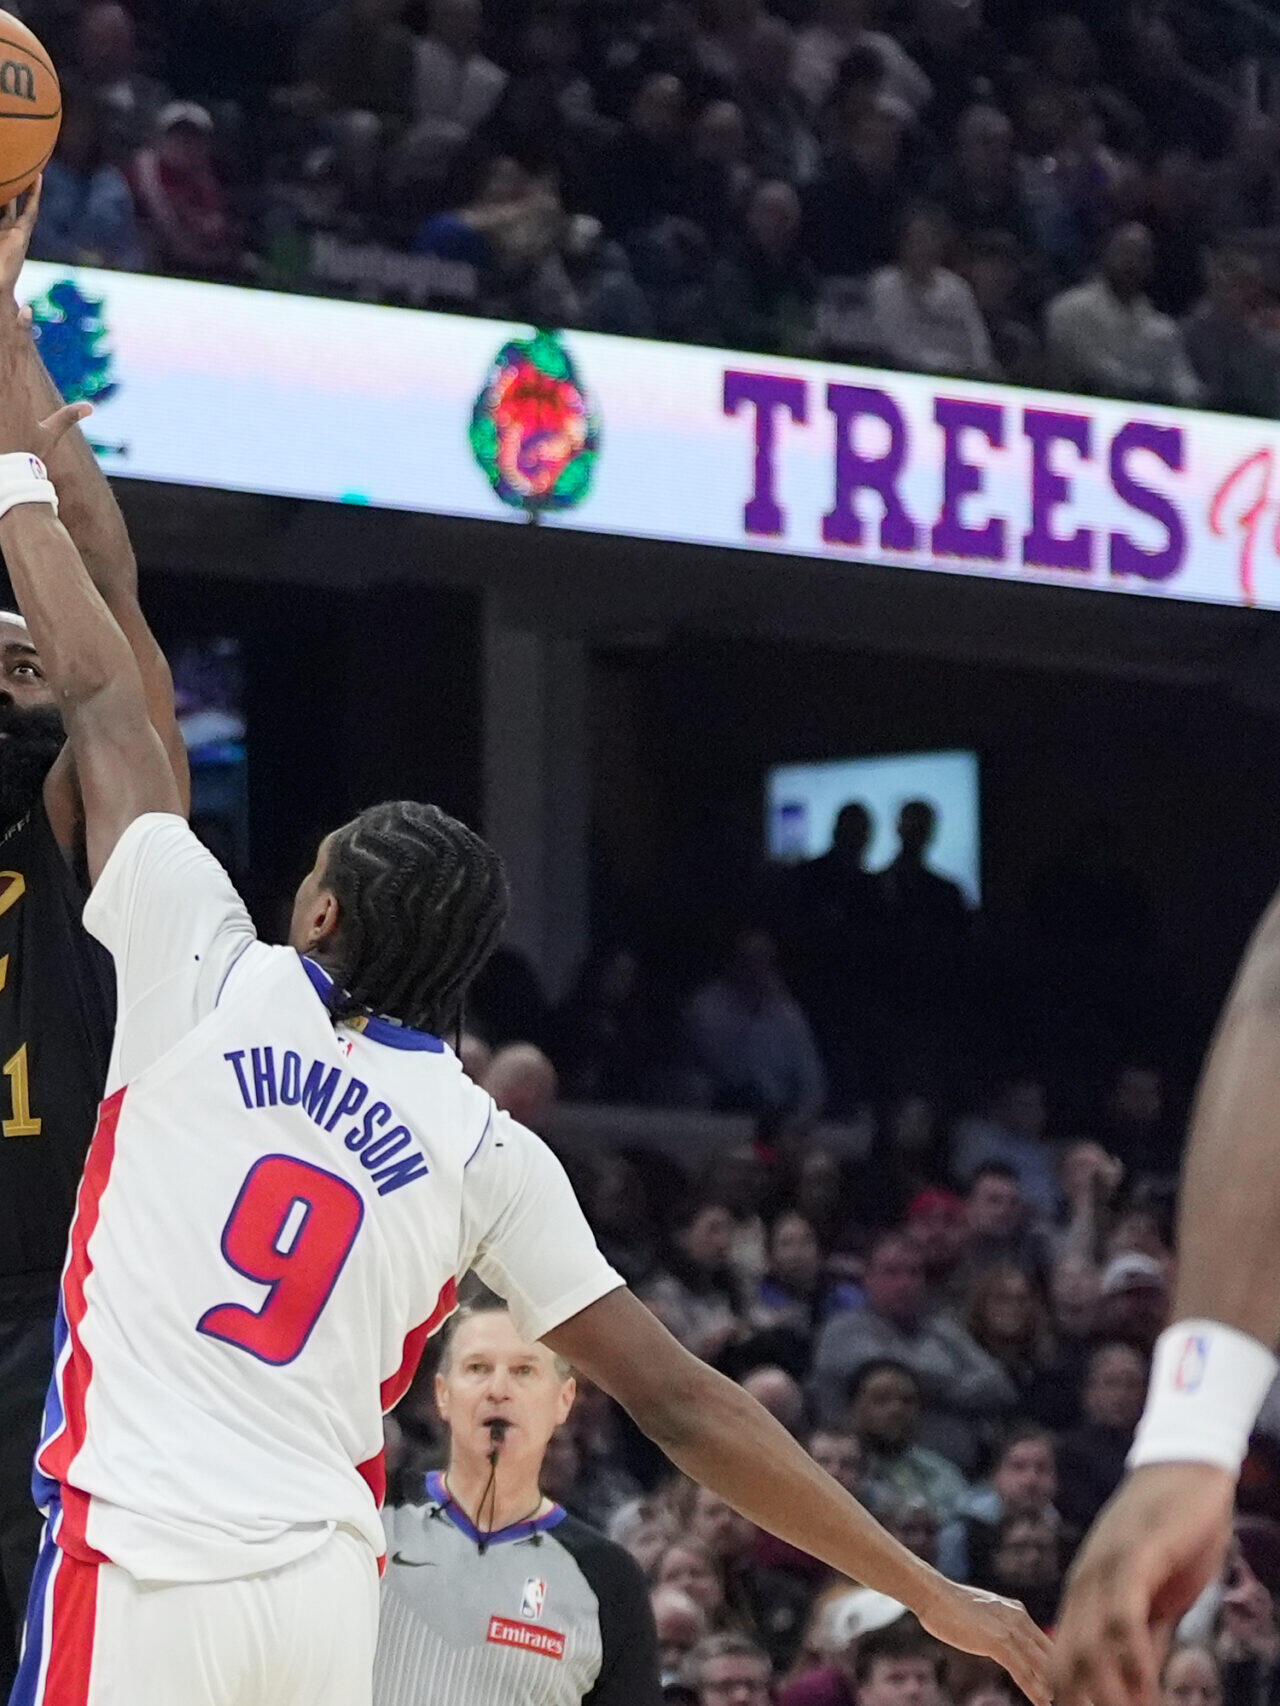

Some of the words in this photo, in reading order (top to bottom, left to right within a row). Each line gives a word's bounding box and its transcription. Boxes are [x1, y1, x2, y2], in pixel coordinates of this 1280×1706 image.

[722, 370, 1187, 582] TREES
[1, 1041, 42, 1138] 1
[223, 1046, 429, 1197] THOMPSON
[195, 1153, 365, 1367] 9
[489, 1621, 563, 1655] Emirates
